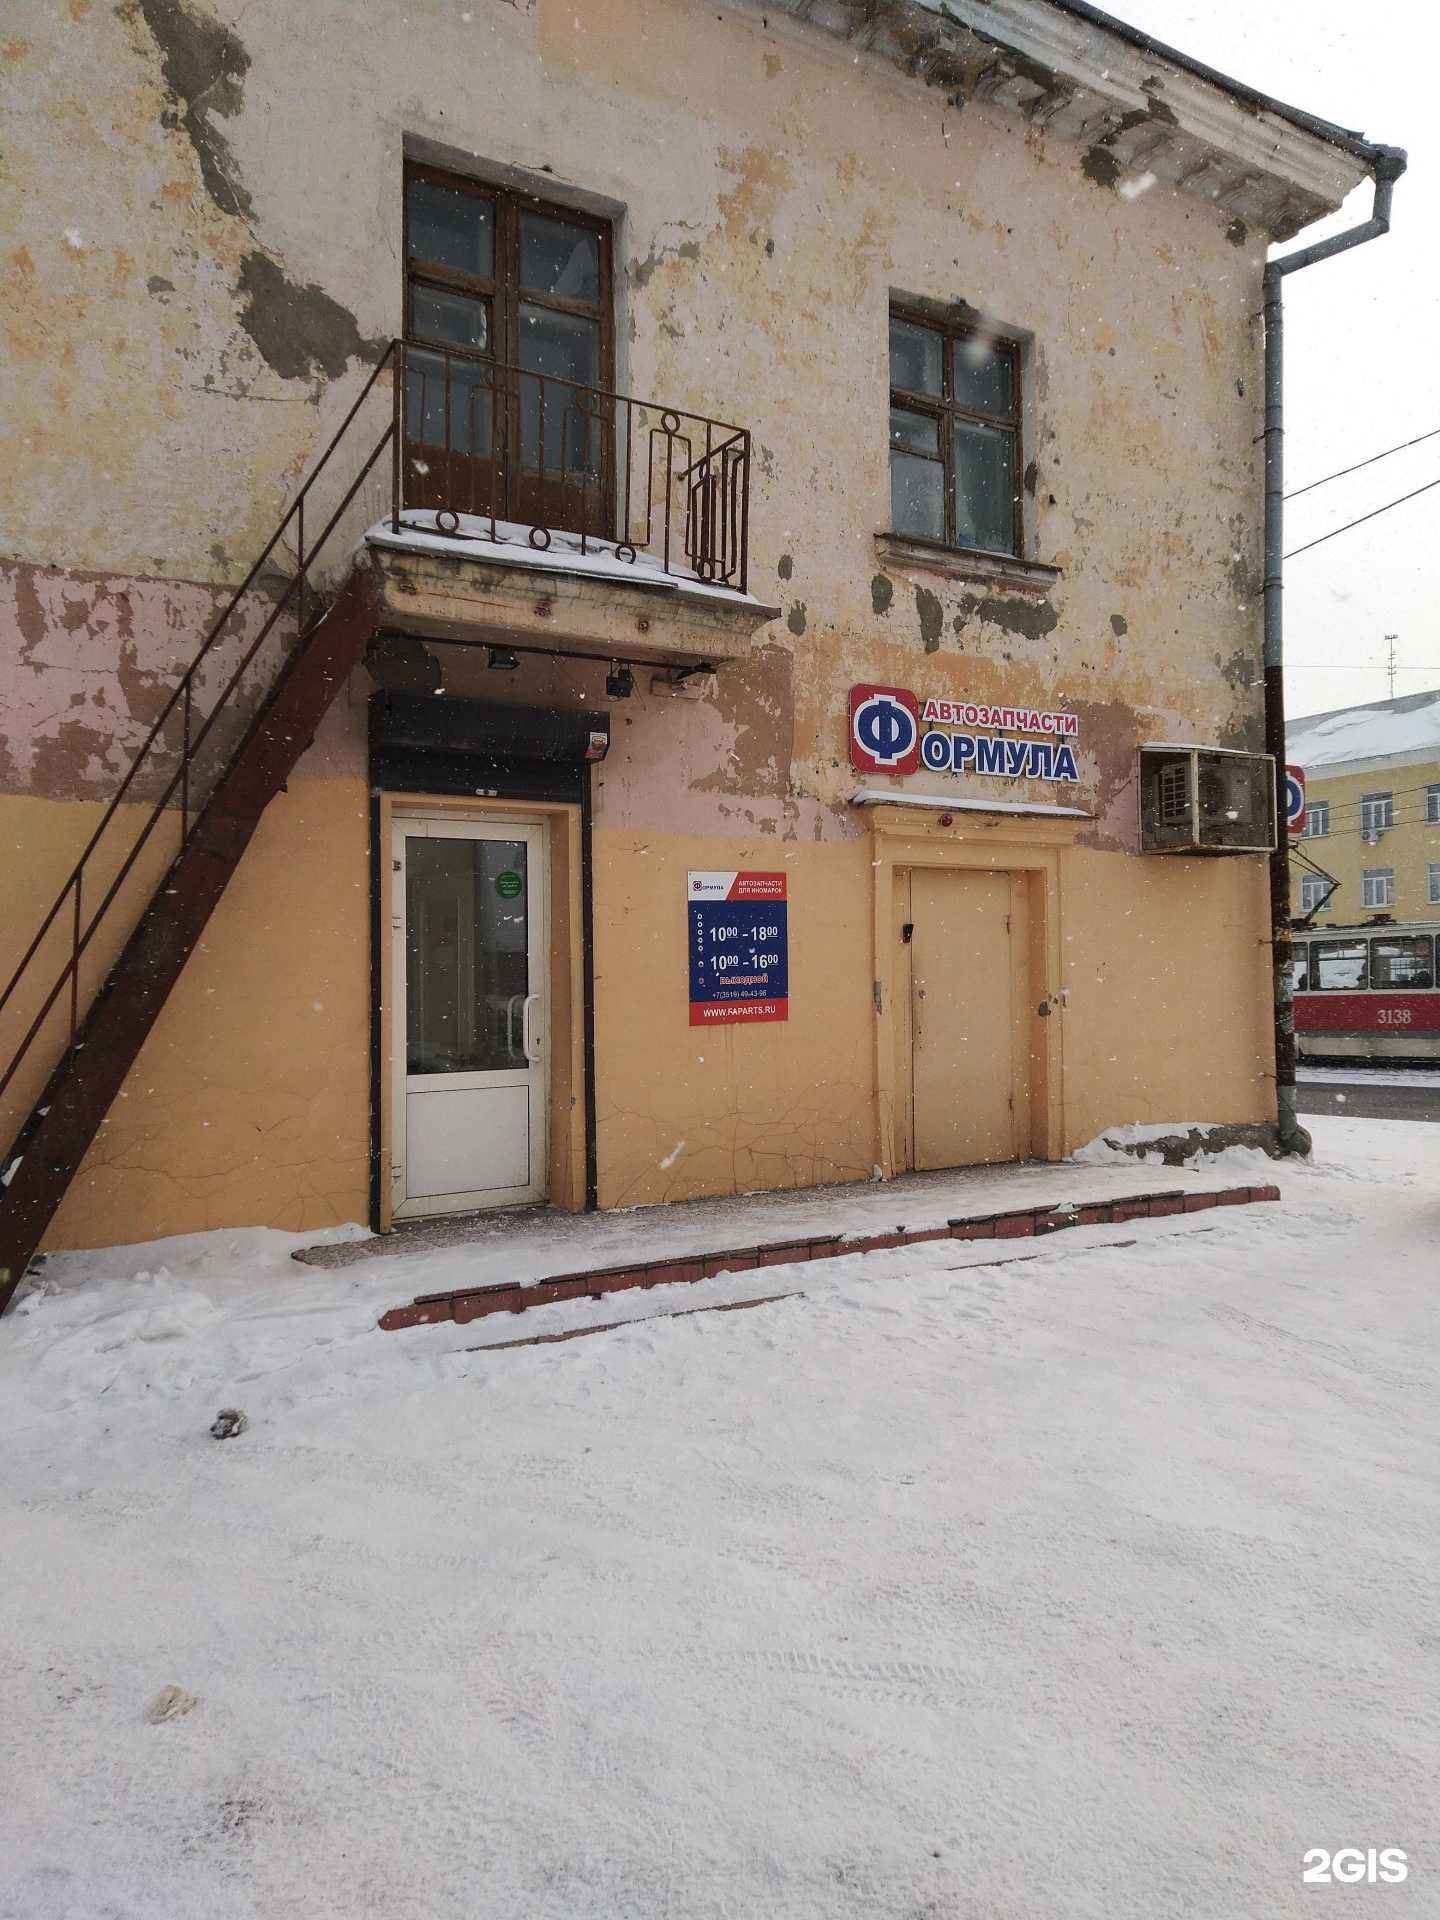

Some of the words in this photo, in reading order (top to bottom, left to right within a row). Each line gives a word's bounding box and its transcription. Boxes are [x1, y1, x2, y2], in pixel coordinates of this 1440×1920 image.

[922, 698, 1079, 736] АВТОЗАПЧАСТИ
[703, 1004, 776, 1017] WWW.FAPARTS.RU
[1377, 1009, 1412, 1024] 3138
